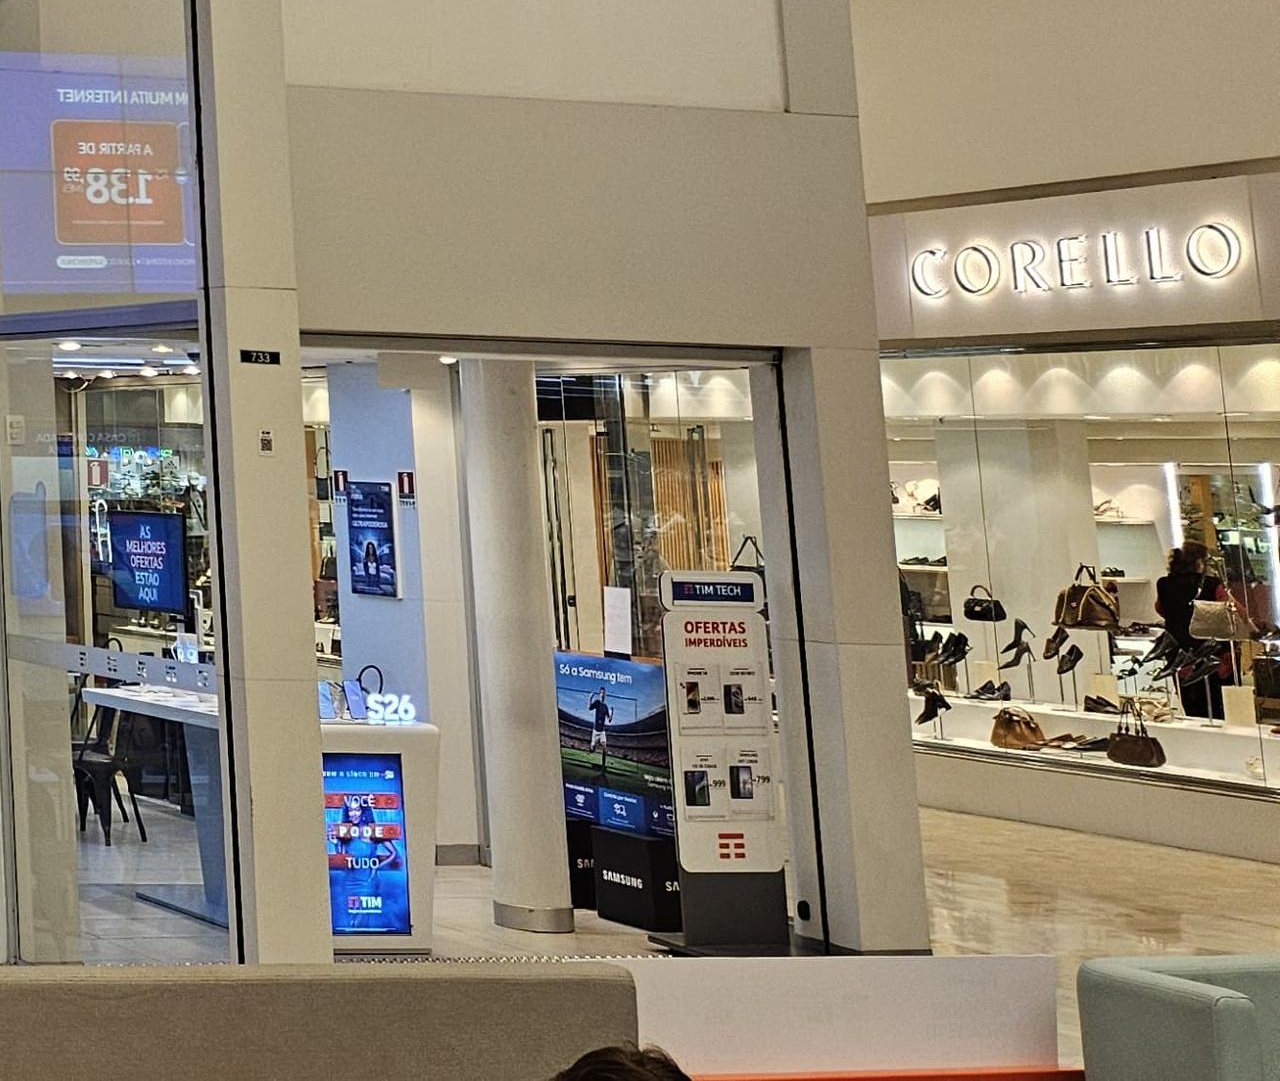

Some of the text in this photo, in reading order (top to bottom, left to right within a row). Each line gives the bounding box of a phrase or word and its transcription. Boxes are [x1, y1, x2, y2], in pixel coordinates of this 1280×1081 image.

[911, 222, 1242, 298] CORELLO
[250, 352, 270, 363] 733
[140, 525, 151, 539] AS
[126, 539, 166, 555] MELHORES
[130, 555, 163, 570] OFERTAS
[135, 569, 160, 586] ESTÃO
[139, 587, 158, 603] AQUI
[695, 585, 741, 596] TIM TECH
[684, 621, 746, 635] OFERTAS
[684, 635, 748, 648] IMPERDÍVEIS
[559, 664, 570, 674] Só
[578, 667, 616, 685] Samsung
[366, 693, 416, 720] S26
[756, 775, 770, 784] 799
[343, 793, 376, 808] VOCÊ
[338, 826, 384, 838] PODE
[345, 857, 379, 869] TUDO
[602, 869, 643, 889] SAMSUNG
[360, 896, 382, 908] TIM
